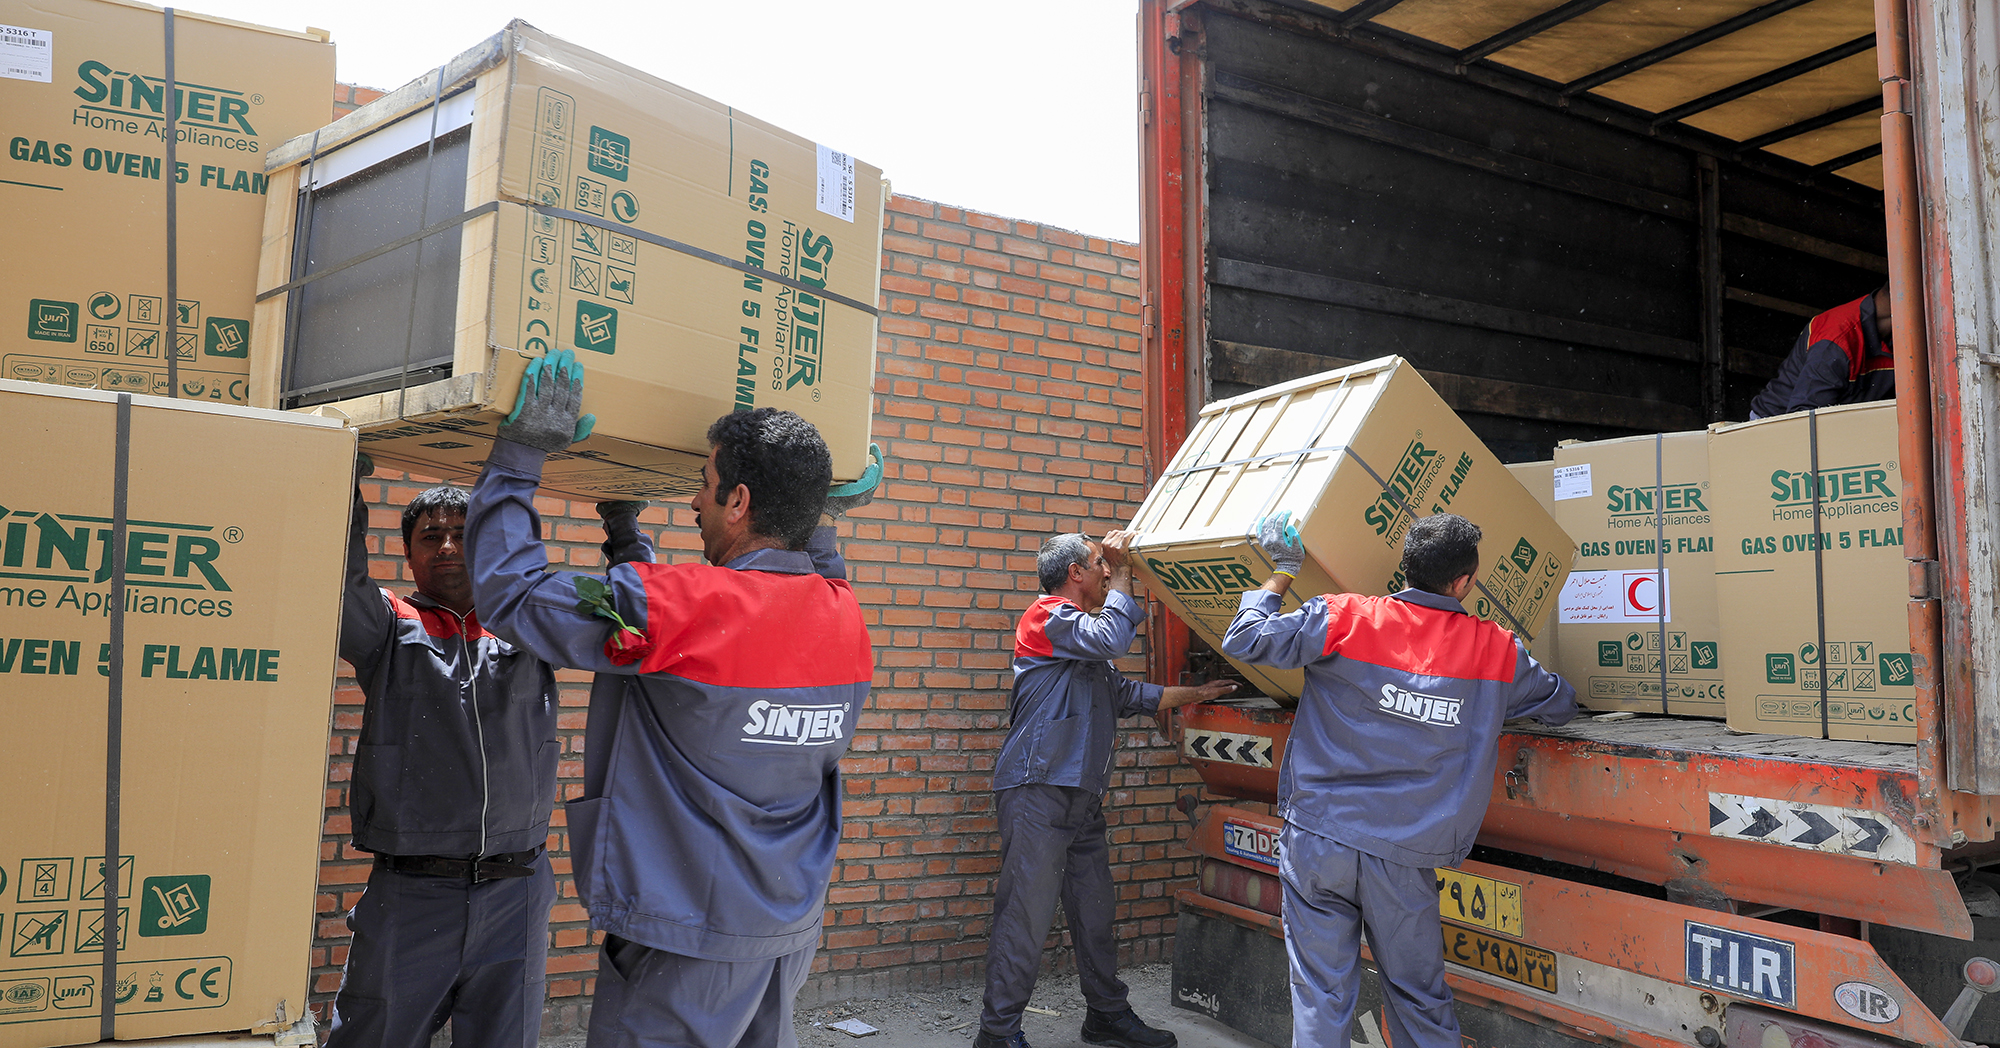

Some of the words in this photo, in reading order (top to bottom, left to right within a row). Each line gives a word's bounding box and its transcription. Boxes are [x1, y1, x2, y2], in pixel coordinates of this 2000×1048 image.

[6, 28, 28, 36] 5316
[73, 60, 258, 136] SINJER
[72, 109, 138, 135] Home
[10, 136, 72, 168] GAS
[83, 147, 161, 180] OVEN
[175, 162, 189, 184] 5
[200, 165, 268, 195] FLAM
[578, 182, 590, 207] 650
[749, 159, 769, 213] GAS
[744, 220, 767, 292] OVEN
[779, 220, 795, 279] Home
[740, 300, 761, 318] 5
[786, 227, 834, 391] SINJER
[90, 341, 114, 352] 650
[772, 286, 791, 391] Appliances
[1364, 441, 1438, 536] SINJER
[1439, 451, 1474, 505] FLAME
[1770, 469, 1897, 503] SINJER
[1385, 514, 1411, 550] Home
[1408, 453, 1446, 512] Appliances
[1772, 507, 1813, 521] Home
[1818, 501, 1899, 519] Appliances
[1607, 517, 1641, 528] Home
[1645, 515, 1711, 529] Appliances
[0, 505, 233, 592] INJER
[1581, 541, 1610, 557] GAS
[1615, 539, 1655, 556] OVEN
[1662, 539, 1671, 554] 5
[1677, 536, 1713, 553] FLA
[1741, 536, 1777, 555] GAS
[1782, 532, 1831, 552] OVEN
[1839, 531, 1850, 549] 5
[1858, 527, 1904, 548] FLA
[1147, 557, 1263, 595] SINJER
[0, 587, 47, 608] me
[0, 638, 81, 676] VEN
[141, 644, 280, 682] FLAME
[1803, 681, 1820, 689] 650
[1379, 684, 1461, 724] SINJER
[742, 700, 844, 745] SINJER
[40, 883, 49, 893] 4
[1500, 887, 1517, 899] ایران
[1692, 933, 1782, 999] T.I.R
[14, 989, 37, 998] IAF
[1179, 988, 1220, 1018] پایتخت
[1860, 990, 1889, 1019] IR
